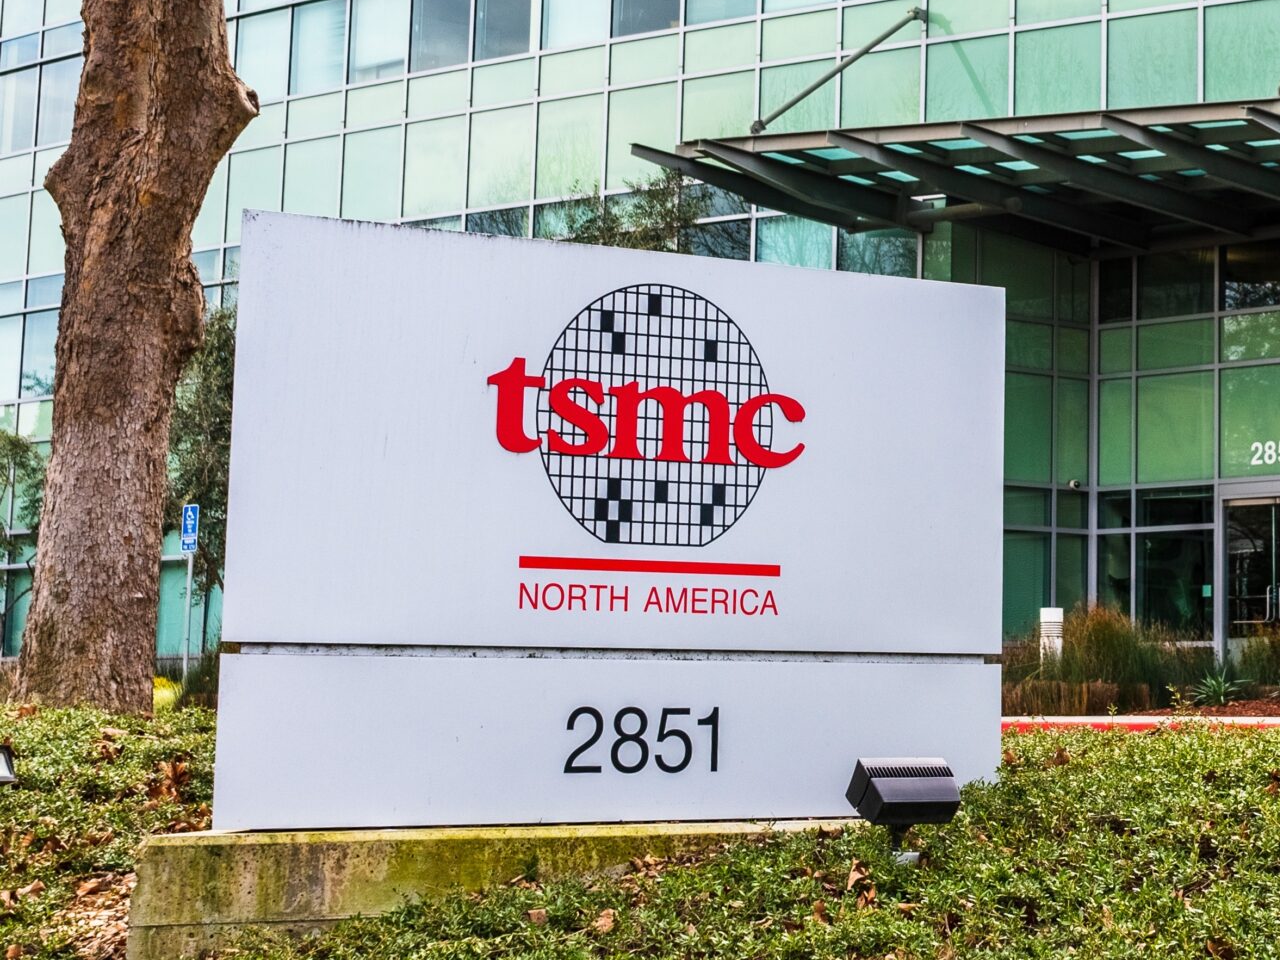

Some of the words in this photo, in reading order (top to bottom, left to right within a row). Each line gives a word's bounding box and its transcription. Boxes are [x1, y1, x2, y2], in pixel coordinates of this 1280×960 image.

[487, 357, 807, 469] tsmc
[518, 582, 629, 612] NORTH
[643, 586, 779, 616] AMERICA
[563, 706, 720, 774] 2851
